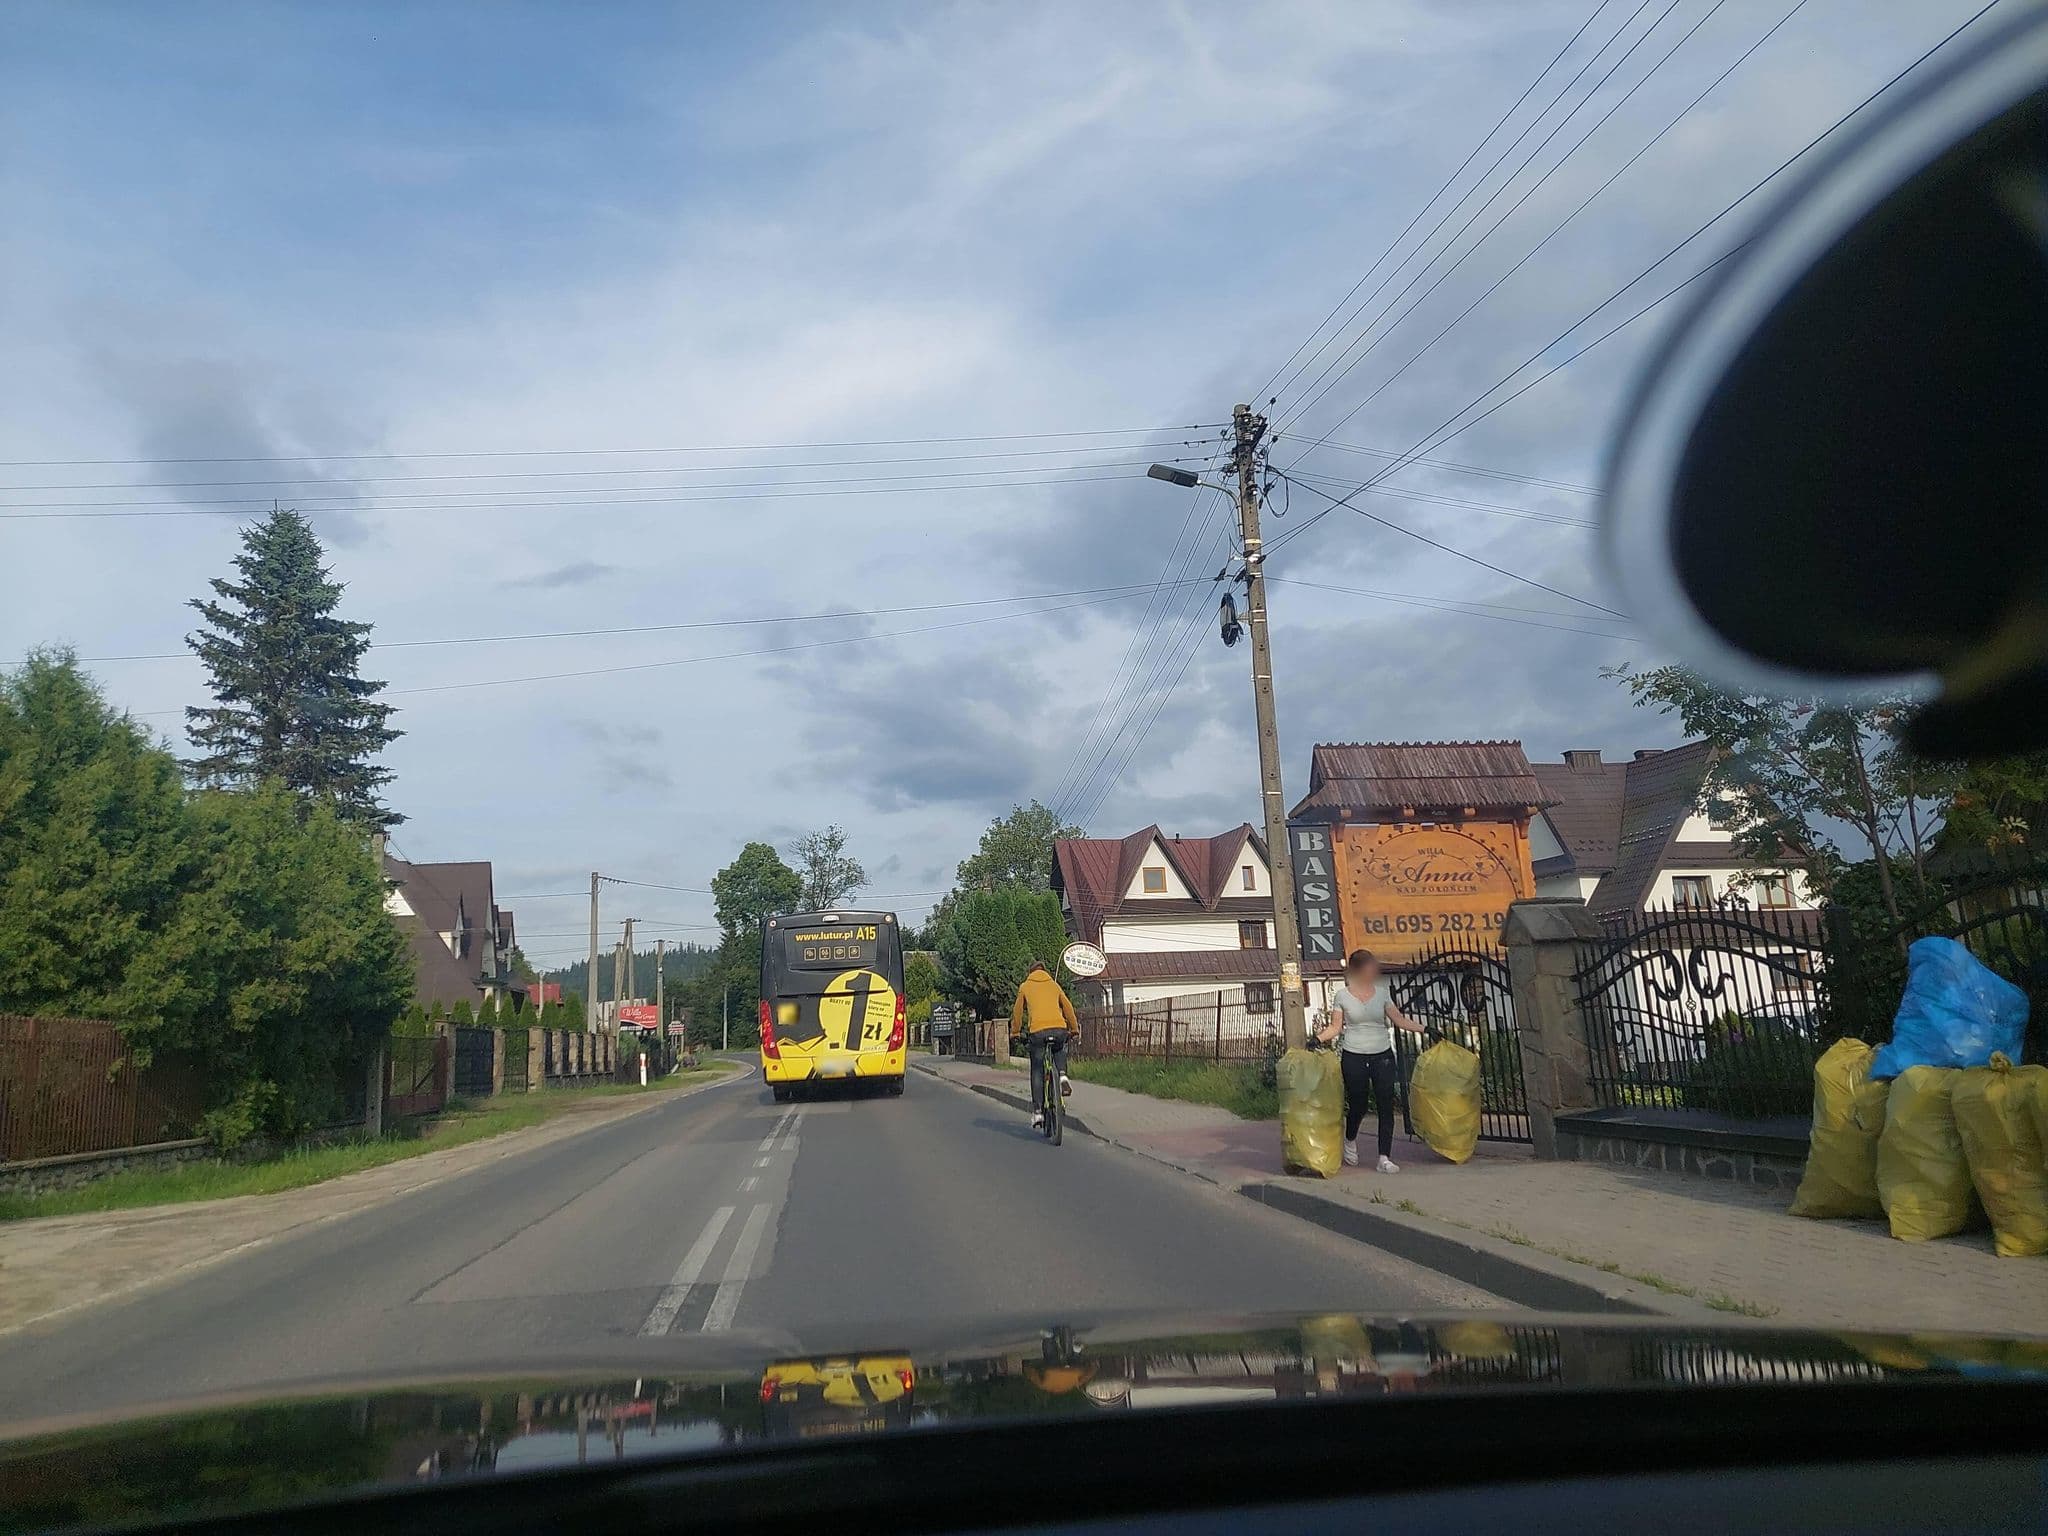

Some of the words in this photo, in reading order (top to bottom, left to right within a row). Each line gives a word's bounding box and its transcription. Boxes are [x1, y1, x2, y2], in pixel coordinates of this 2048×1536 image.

[1417, 848, 1445, 856] WILLA
[1392, 861, 1475, 883] Anna
[1297, 832, 1335, 953] BASEN
[1396, 886, 1417, 894] NAD
[1440, 912, 1476, 932] 282
[795, 929, 854, 941] www.lutur.pl
[856, 926, 877, 940] A15
[845, 972, 873, 1051] 1
[864, 1022, 883, 1040] zł
